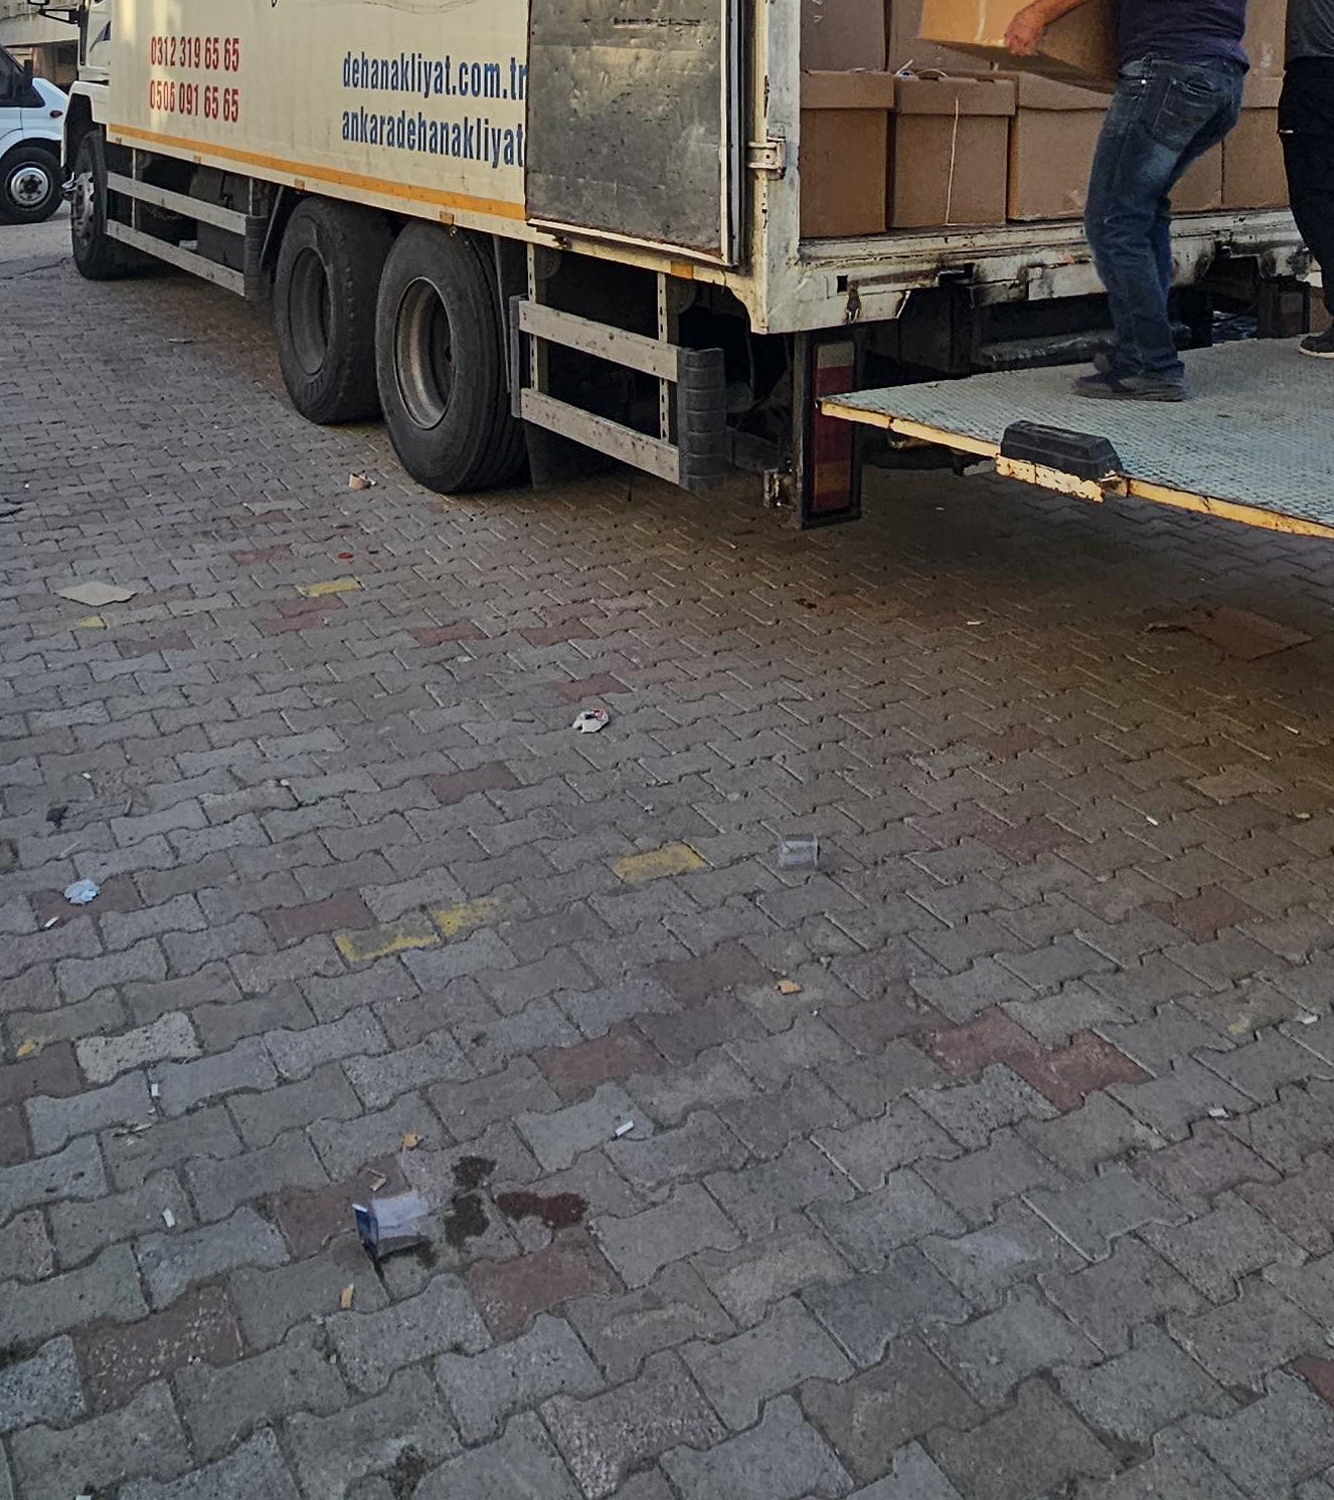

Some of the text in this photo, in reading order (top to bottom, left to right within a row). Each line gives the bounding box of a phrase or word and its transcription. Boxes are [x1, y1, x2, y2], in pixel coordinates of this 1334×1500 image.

[151, 36, 240, 72] 0312 319 65 65
[343, 51, 527, 101] dehanakliyat.com.tr
[150, 80, 239, 123] 0506 091 65 65
